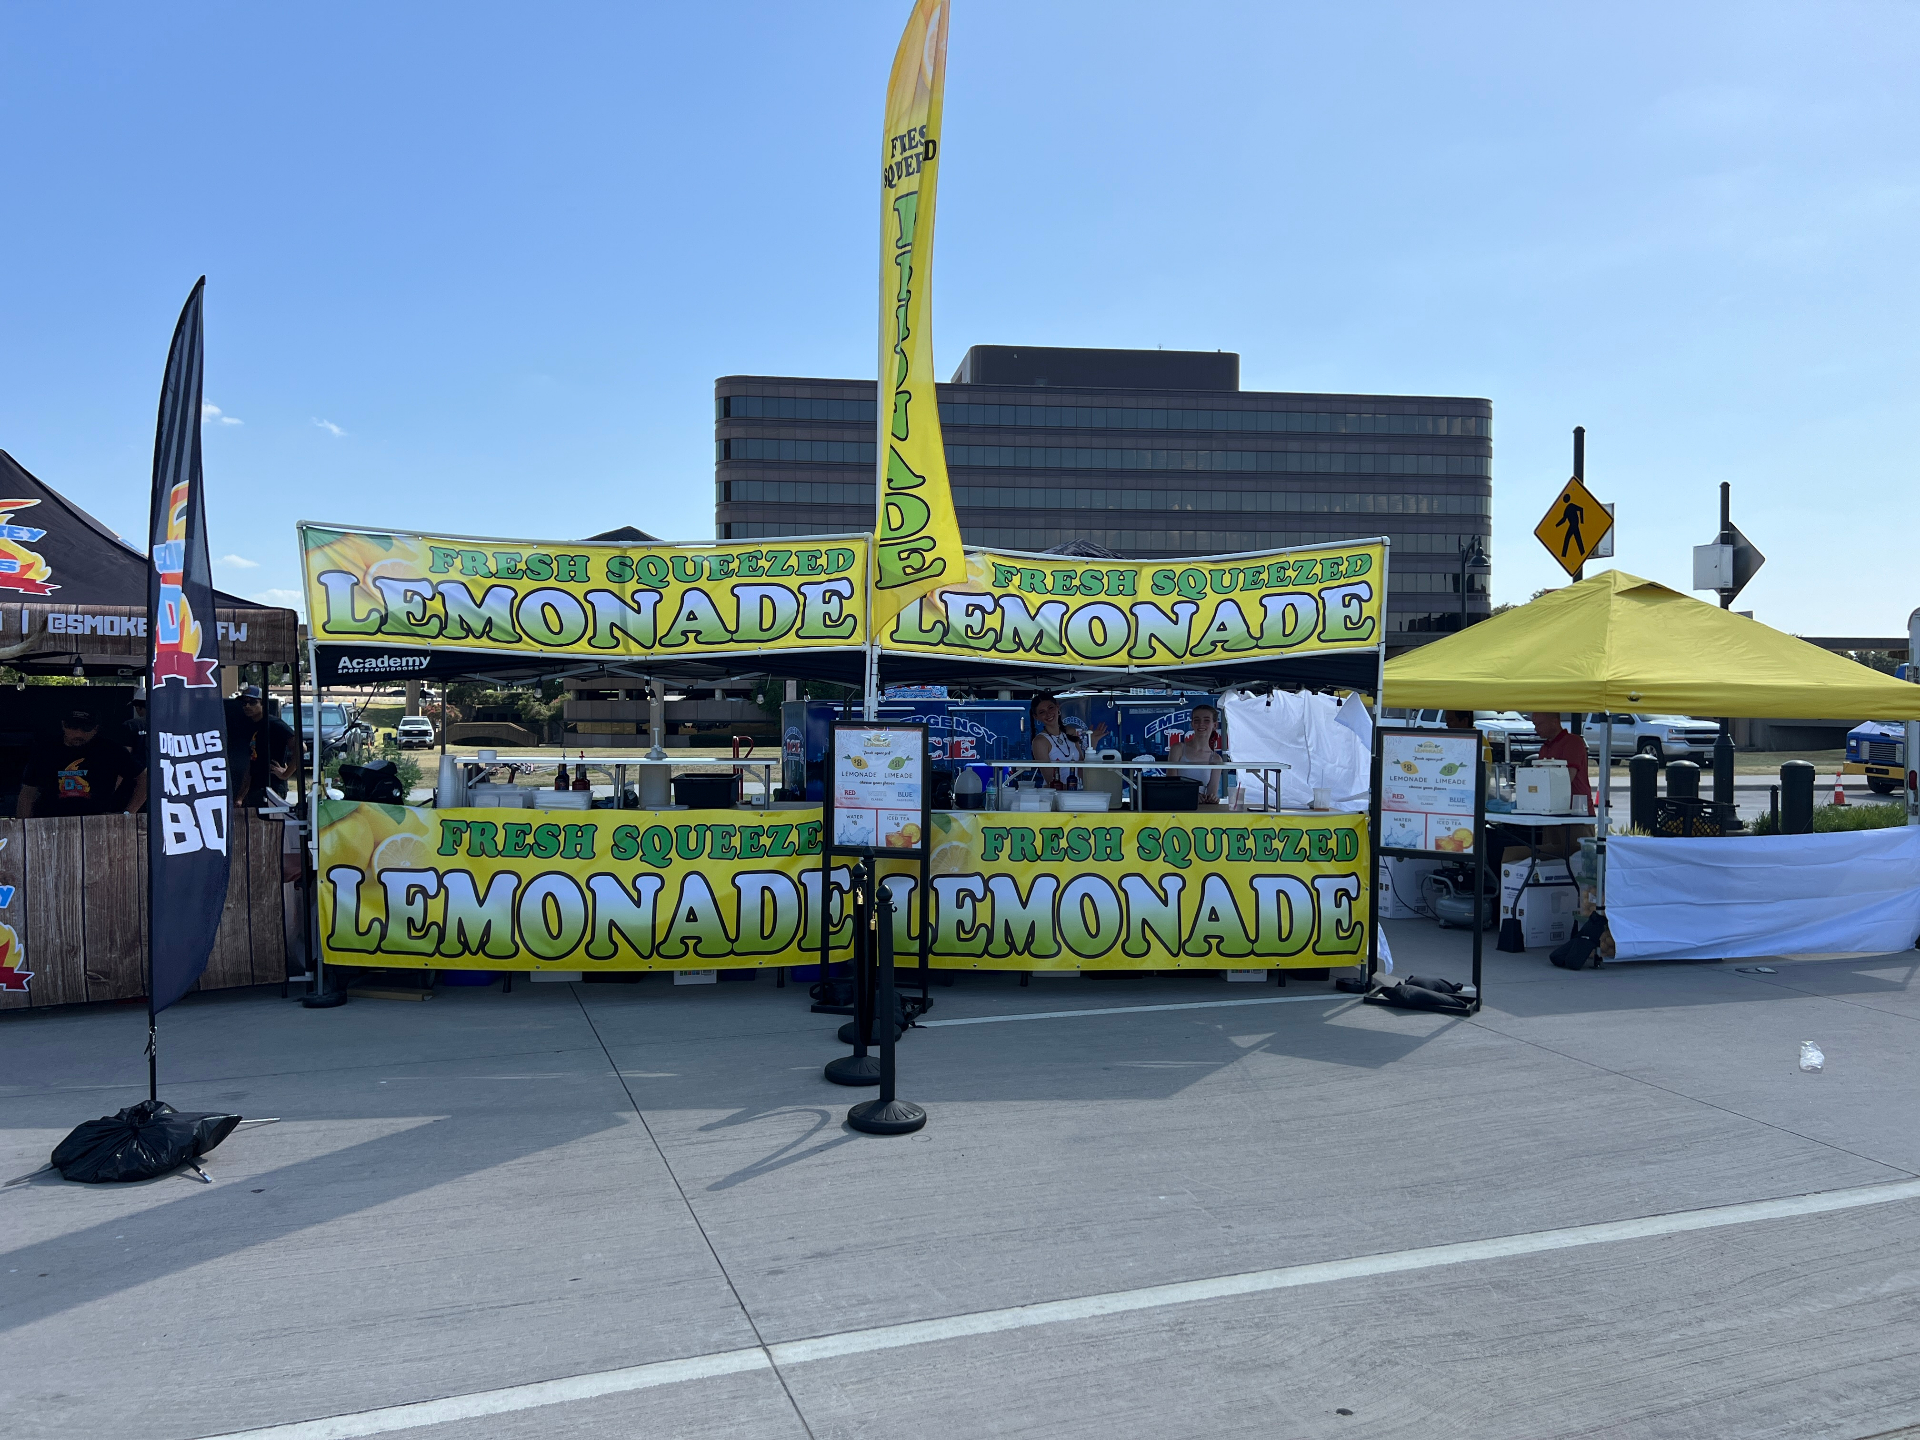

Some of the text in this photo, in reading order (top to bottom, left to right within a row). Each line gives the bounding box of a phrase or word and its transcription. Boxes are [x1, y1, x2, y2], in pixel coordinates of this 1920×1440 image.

[429, 546, 855, 588] FRESH SQUEEZED
[992, 553, 1373, 600] FRESH SQUEEZED
[317, 570, 858, 649] LEMONADE
[890, 580, 1376, 660] LEMONADE
[338, 655, 431, 669] Academy
[1389, 775, 1428, 783] LEMONADE
[437, 819, 823, 868] FRESH SQUEEZE
[981, 826, 1359, 869] FRESH SQUEEZED
[326, 864, 855, 960] LEMONADE
[878, 872, 1364, 959] LEMONADE
